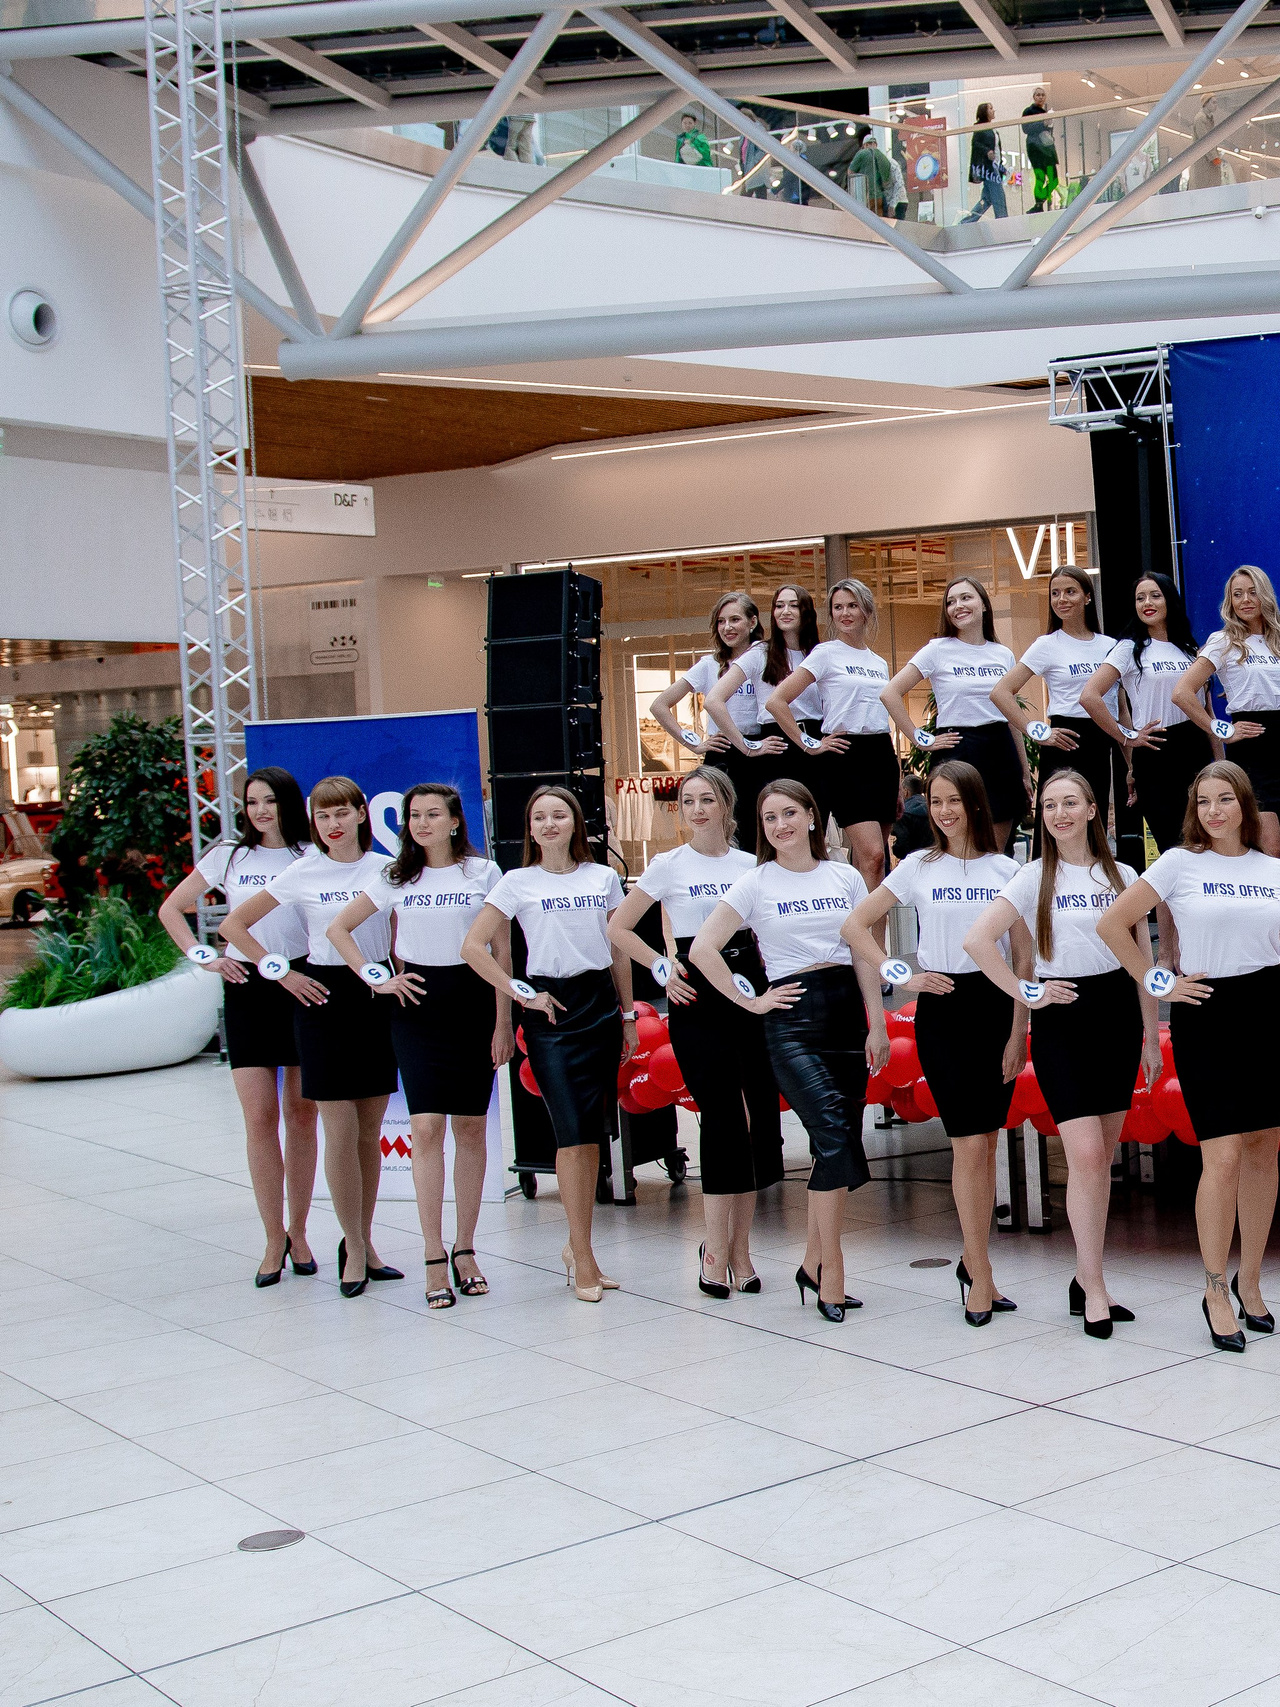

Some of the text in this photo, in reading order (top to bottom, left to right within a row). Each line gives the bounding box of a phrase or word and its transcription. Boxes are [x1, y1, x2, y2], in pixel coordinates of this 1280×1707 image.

[1031, 723, 1048, 739] 22
[1215, 721, 1229, 737] 25
[684, 731, 697, 743] 17
[917, 731, 930, 744] 21
[1239, 884, 1276, 899] OFFICE
[435, 892, 472, 906] OFFICE
[574, 895, 607, 909] OFFICE
[812, 897, 850, 911] OFFICE
[196, 949, 210, 960] 2
[266, 961, 282, 973] 3
[367, 968, 382, 980] 5
[657, 964, 667, 978] 7
[885, 962, 908, 980] 10
[739, 981, 750, 993] 8
[1151, 970, 1171, 993] 12
[1024, 983, 1039, 999] 11
